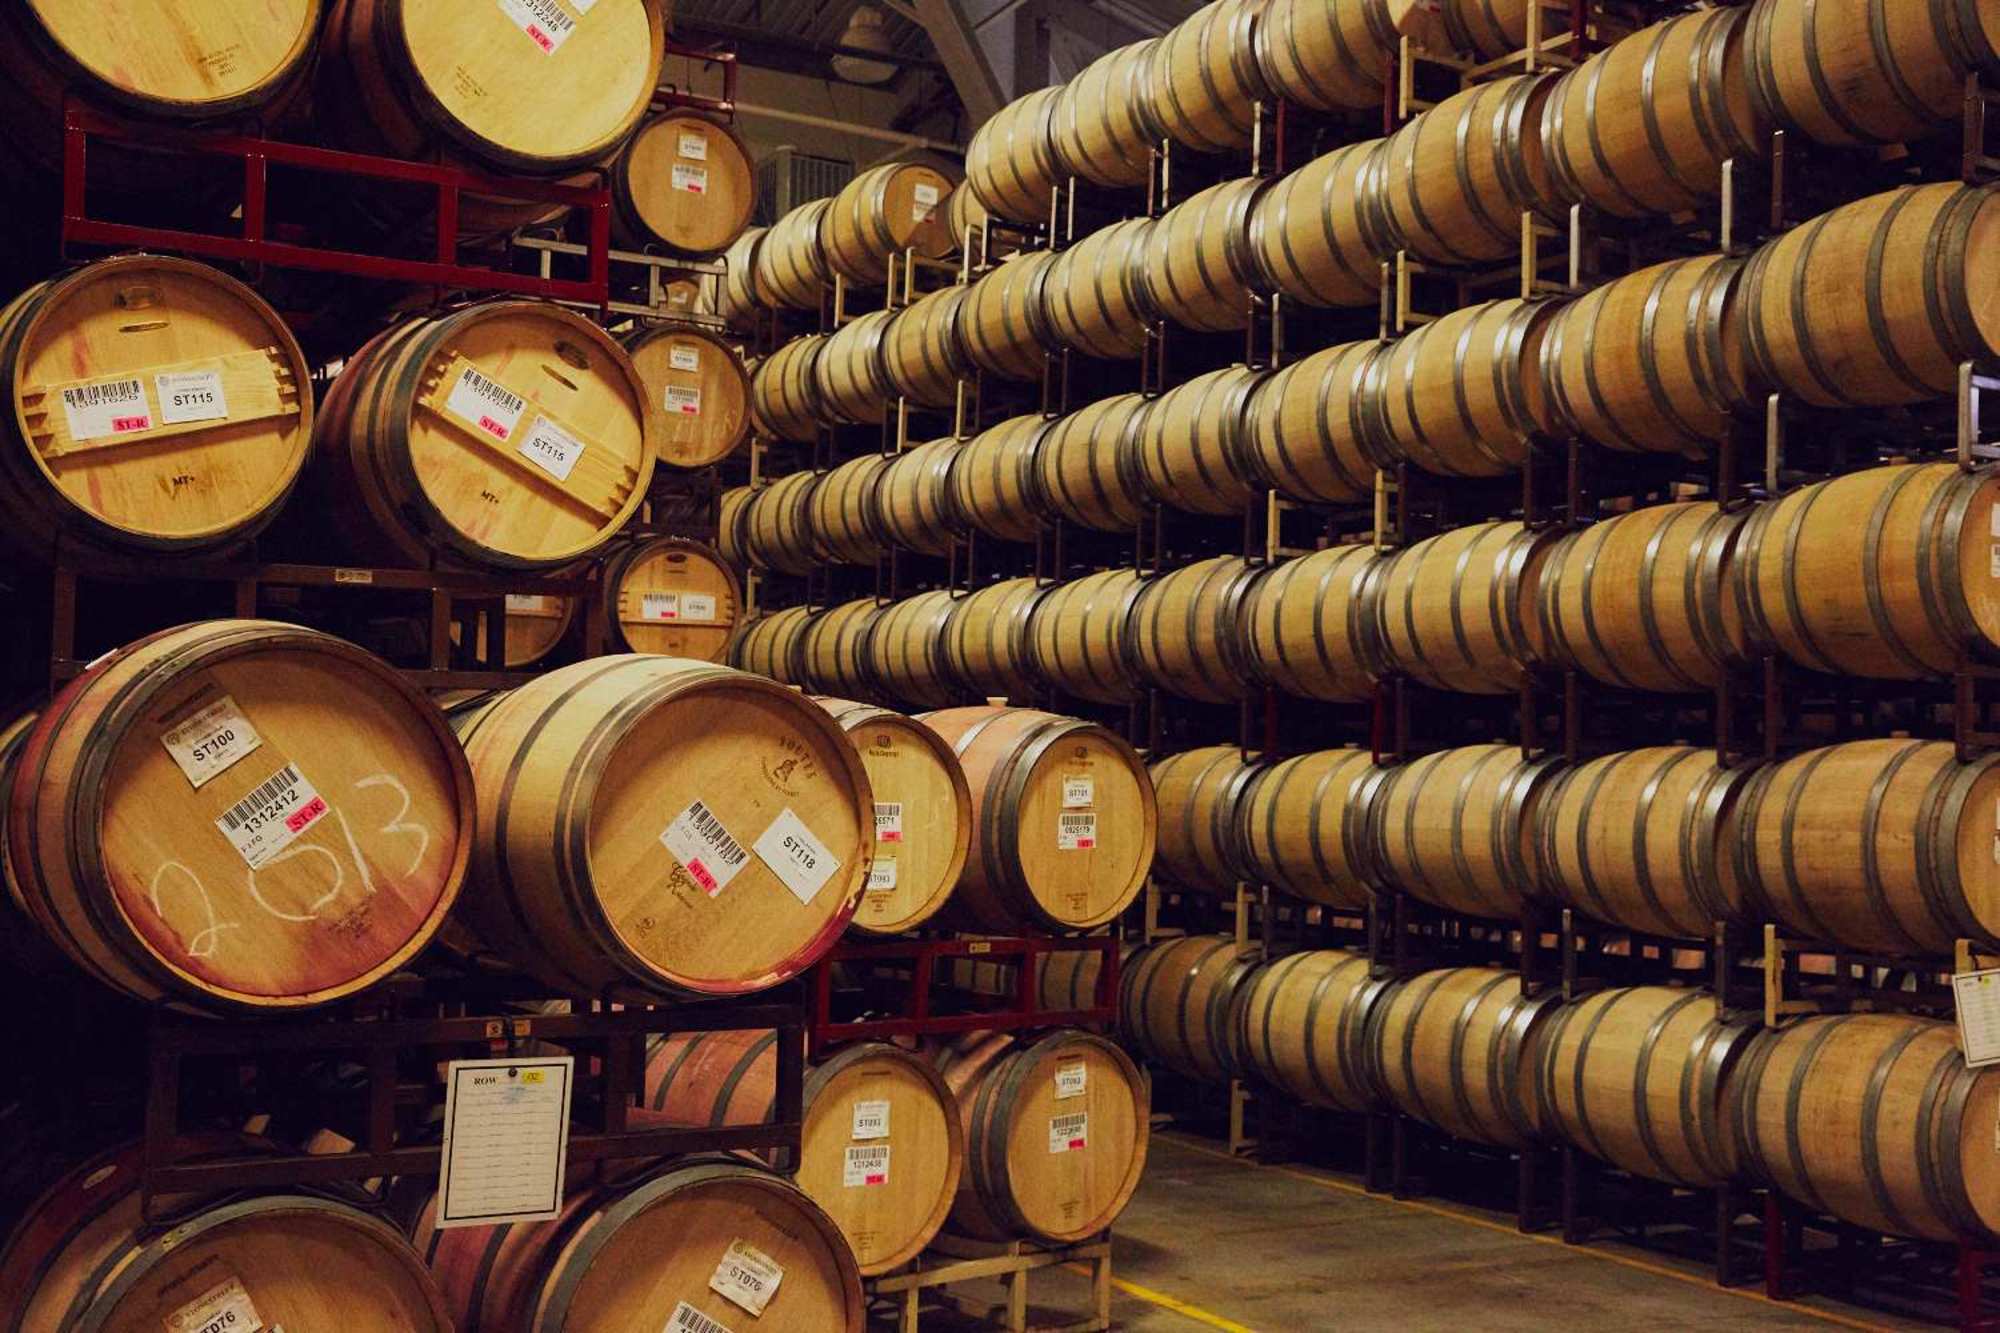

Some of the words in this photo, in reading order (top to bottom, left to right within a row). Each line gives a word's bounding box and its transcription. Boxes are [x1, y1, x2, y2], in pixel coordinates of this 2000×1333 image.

[174, 392, 214, 406] ST115
[532, 437, 566, 462] ST115
[193, 730, 235, 761] ST100
[244, 789, 299, 834] 1312412
[152, 773, 429, 957] 2013
[783, 836, 816, 870] ST118
[473, 1076, 497, 1086] ROW
